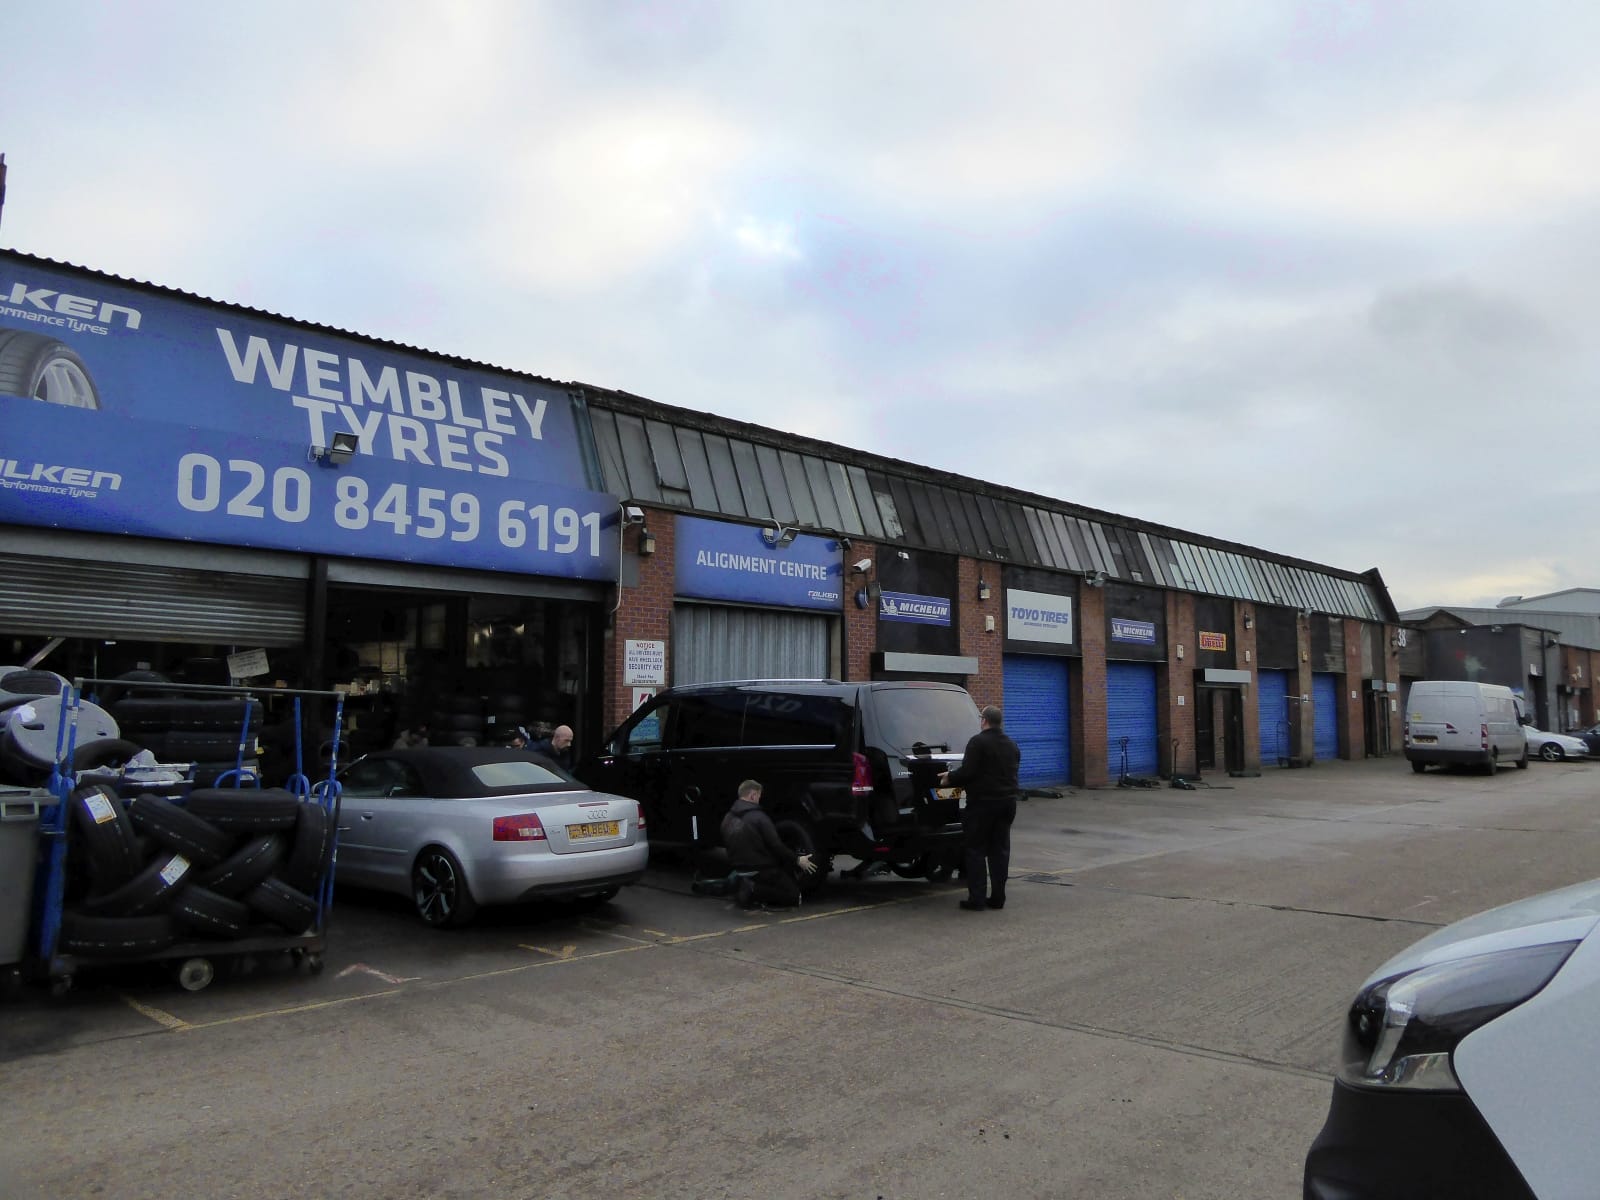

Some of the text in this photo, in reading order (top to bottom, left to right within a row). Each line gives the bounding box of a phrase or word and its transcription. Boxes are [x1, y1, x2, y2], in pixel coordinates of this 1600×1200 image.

[66, 317, 109, 336] Tyres
[215, 327, 548, 441] WEMBLEY
[291, 395, 510, 478] TYRES
[68, 486, 97, 498] Tyres
[177, 453, 600, 557] 020 8459 6191
[696, 550, 828, 581] ALIGNMENT CENTRE
[899, 602, 948, 616] MICHELIN
[1011, 606, 1069, 625] TOYO TIRES
[1122, 626, 1153, 637] MICHELIN
